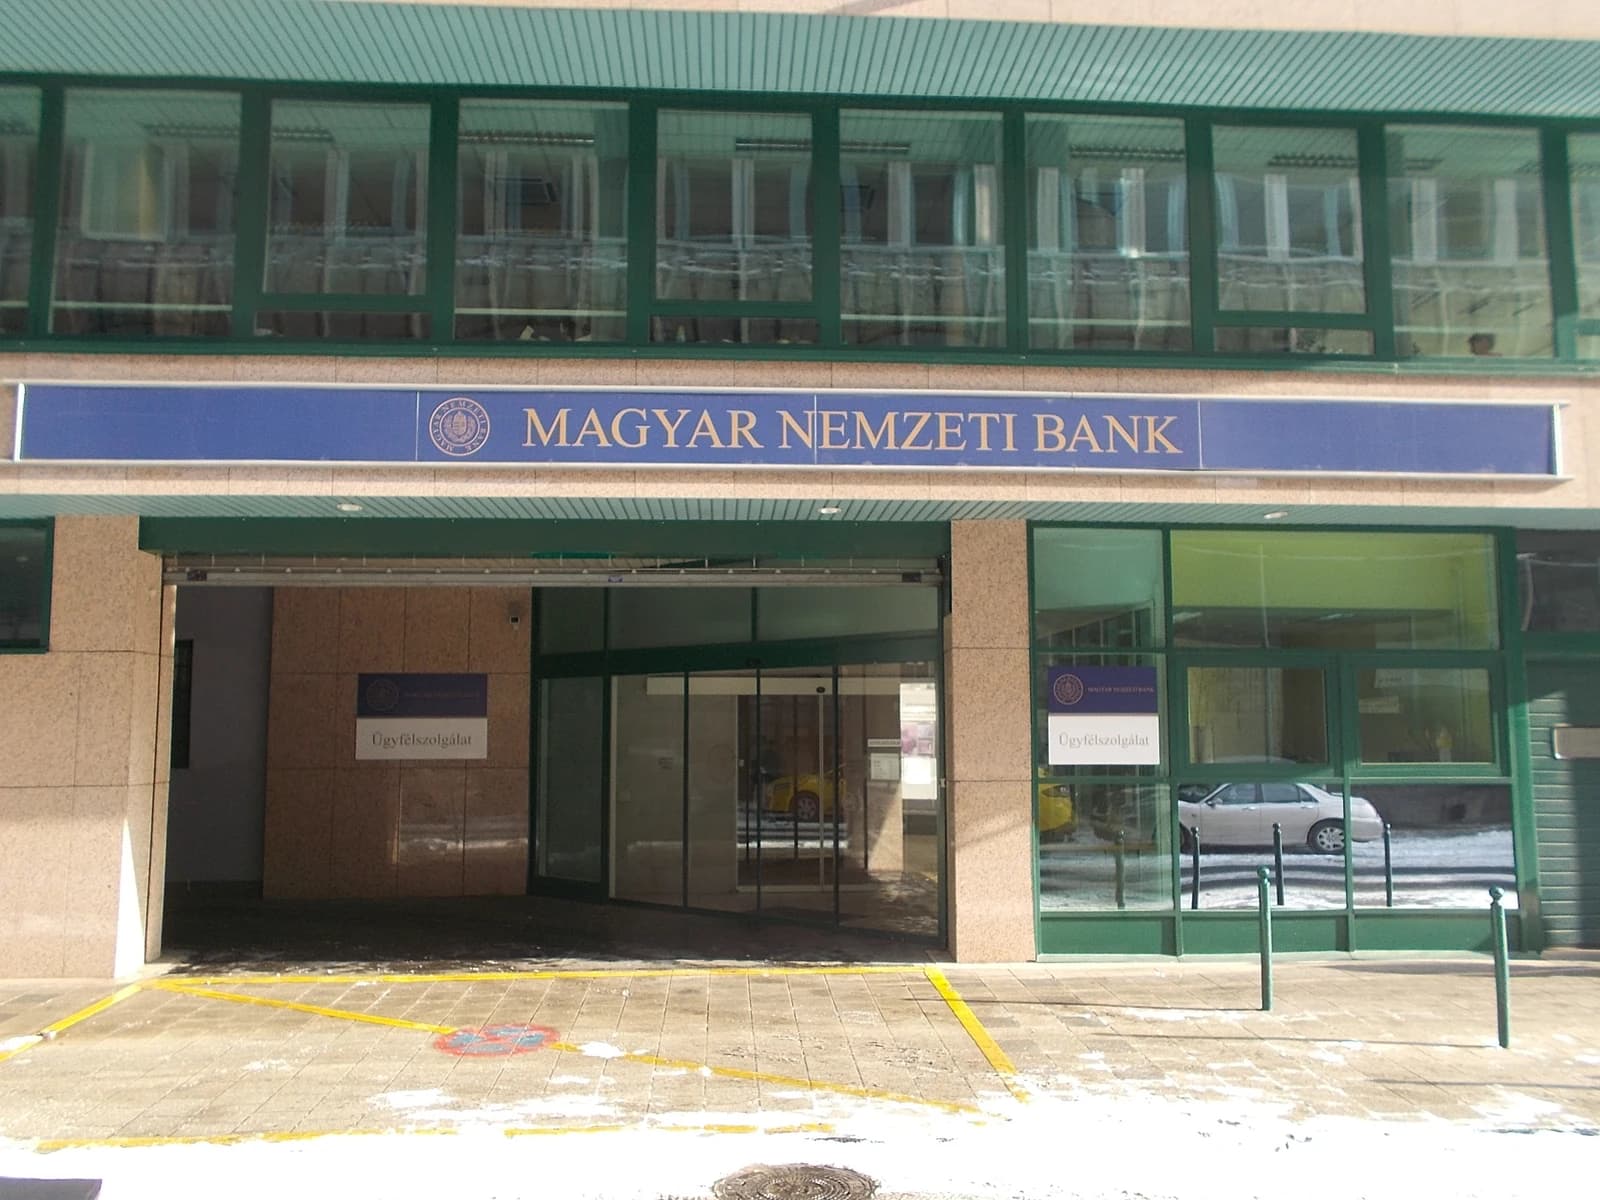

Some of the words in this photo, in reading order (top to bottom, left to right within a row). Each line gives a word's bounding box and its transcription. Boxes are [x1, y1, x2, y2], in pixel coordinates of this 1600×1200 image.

[522, 408, 764, 449] MAGYAR
[776, 410, 1018, 452] NEMZETI
[1034, 413, 1183, 455] BANK
[372, 731, 472, 749] Ügyfélszolgálat
[1058, 731, 1150, 749] Ügyfélszolgálat
